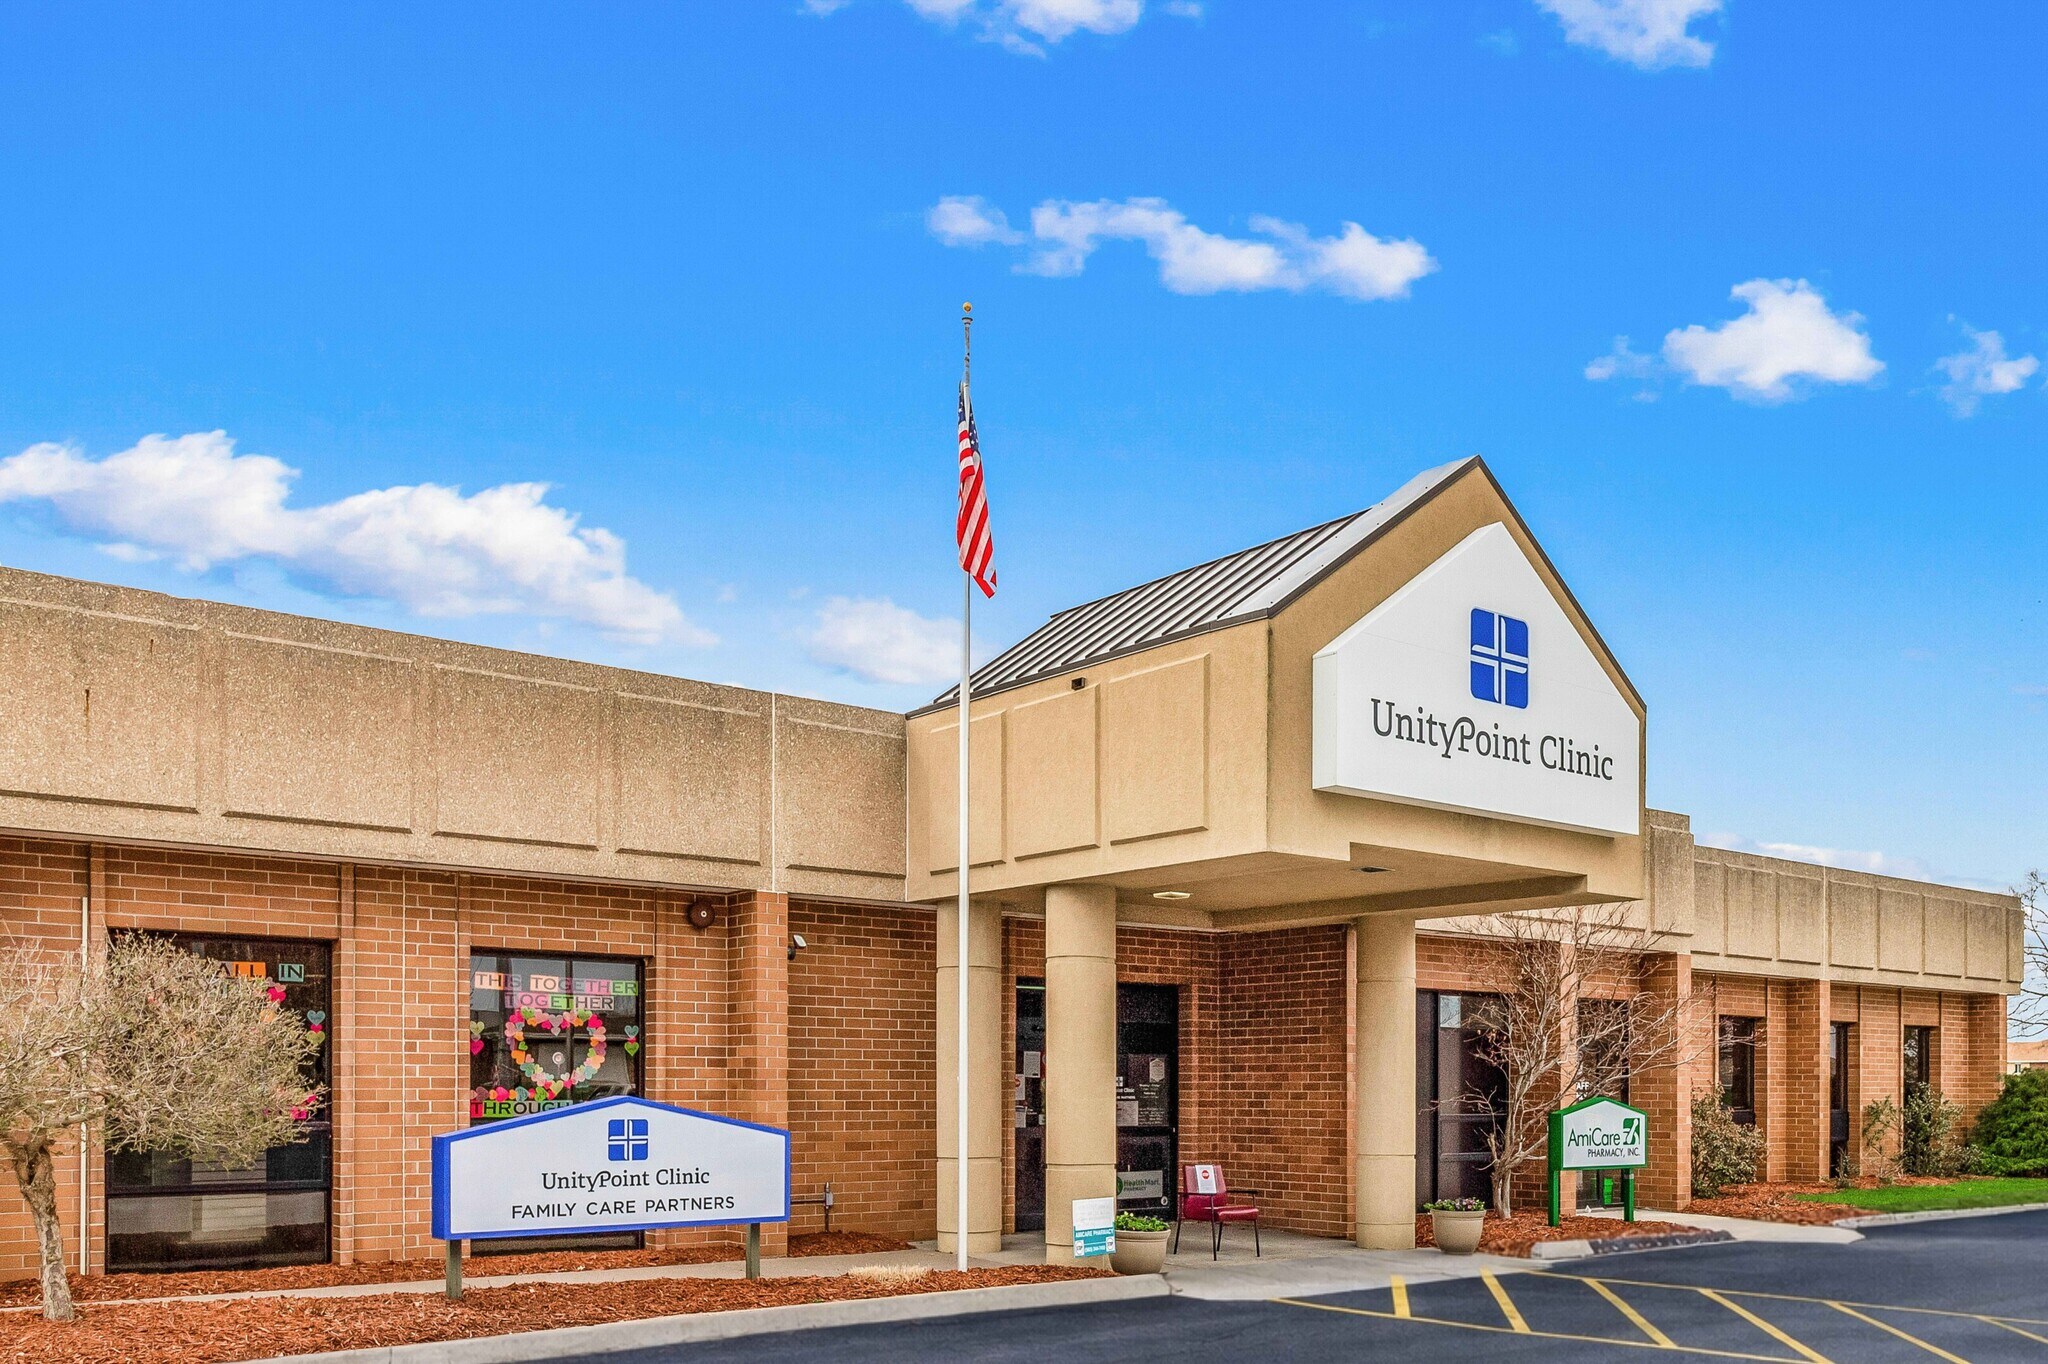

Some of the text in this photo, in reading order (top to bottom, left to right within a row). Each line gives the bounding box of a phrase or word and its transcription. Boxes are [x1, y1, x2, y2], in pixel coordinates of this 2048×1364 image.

[1371, 698, 1613, 781] UnityPoint Clinic
[281, 965, 302, 979] IN
[476, 973, 637, 994] THIS TOGETHER
[506, 994, 613, 1010] TOGETHER
[1568, 1127, 1621, 1147] AmiCare
[1587, 1147, 1640, 1158] PHARMACY, INC.
[542, 1168, 710, 1192] UnityPoint Clinic
[512, 1196, 735, 1219] FAMILY CARE PARTNERS
